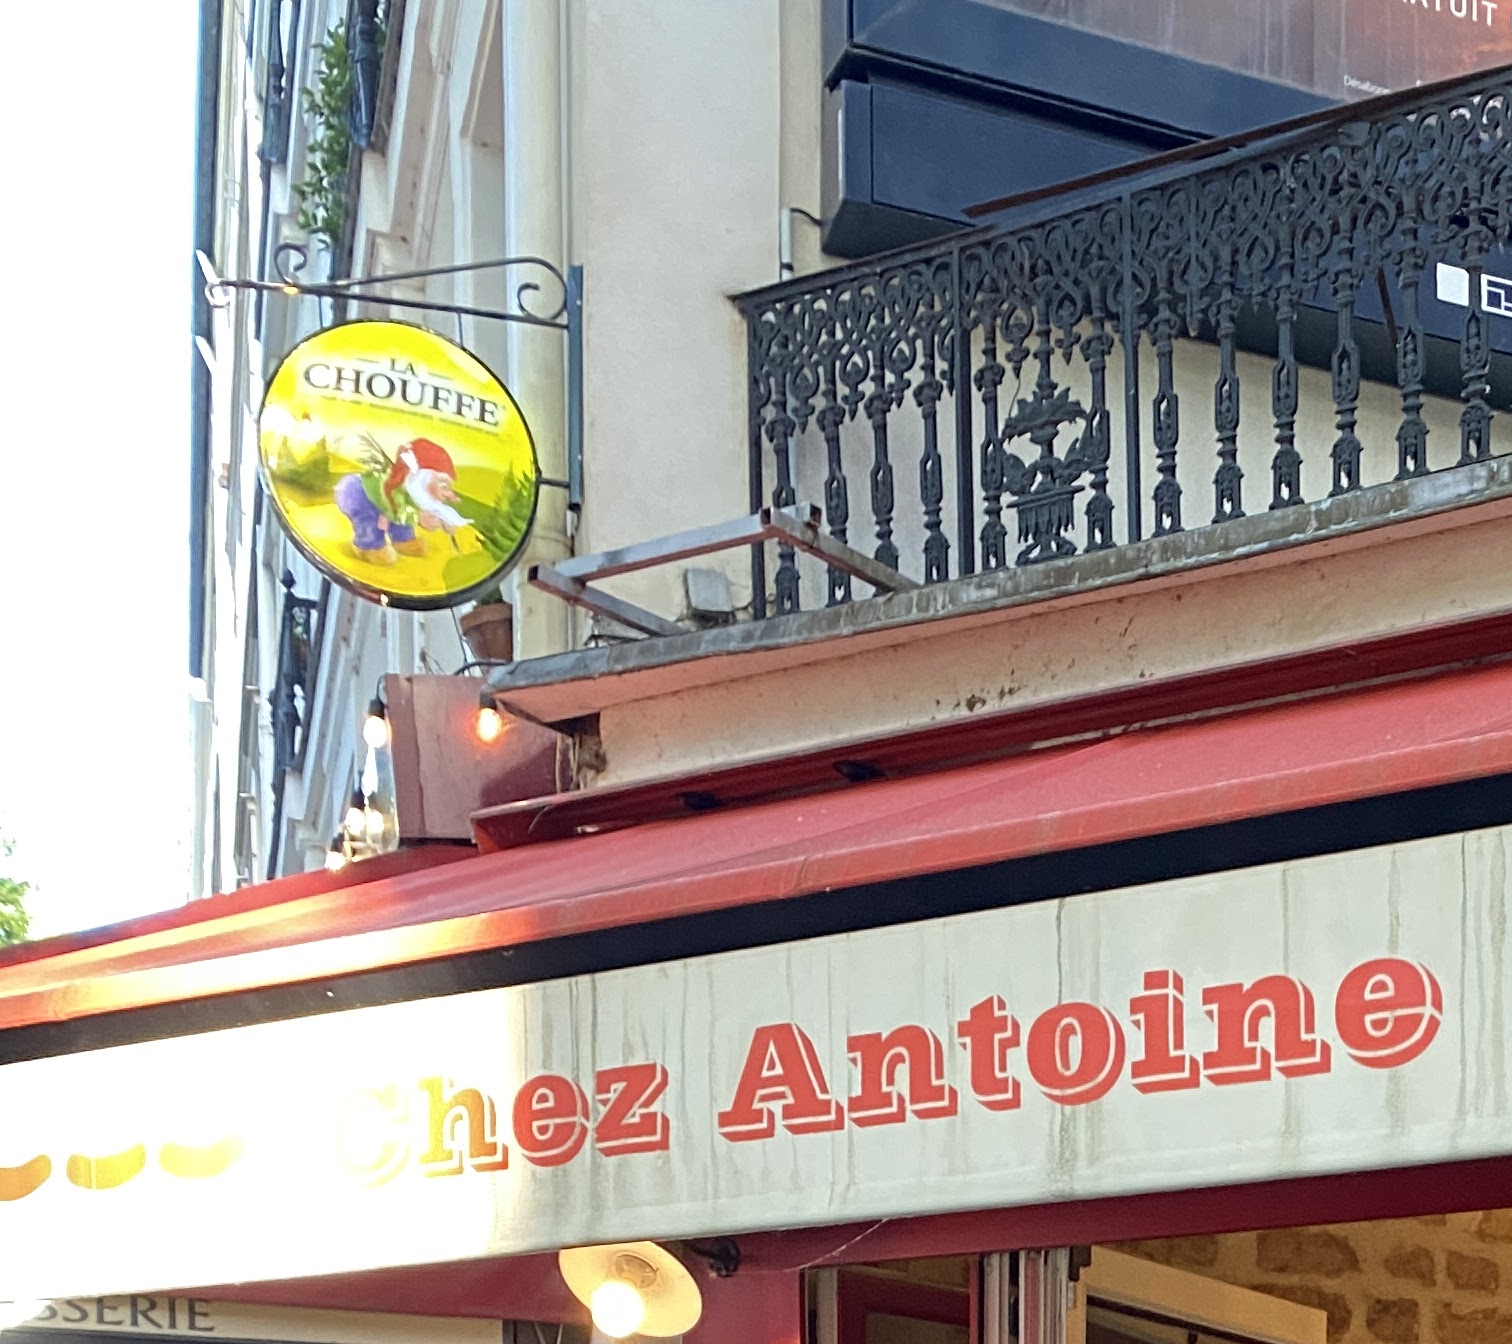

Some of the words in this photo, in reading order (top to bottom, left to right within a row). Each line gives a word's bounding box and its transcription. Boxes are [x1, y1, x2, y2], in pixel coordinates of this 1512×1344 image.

[303, 363, 499, 427] CHOUFFE
[390, 358, 416, 377] LA
[339, 1062, 671, 1188] Chez
[718, 957, 1443, 1142] Antoine
